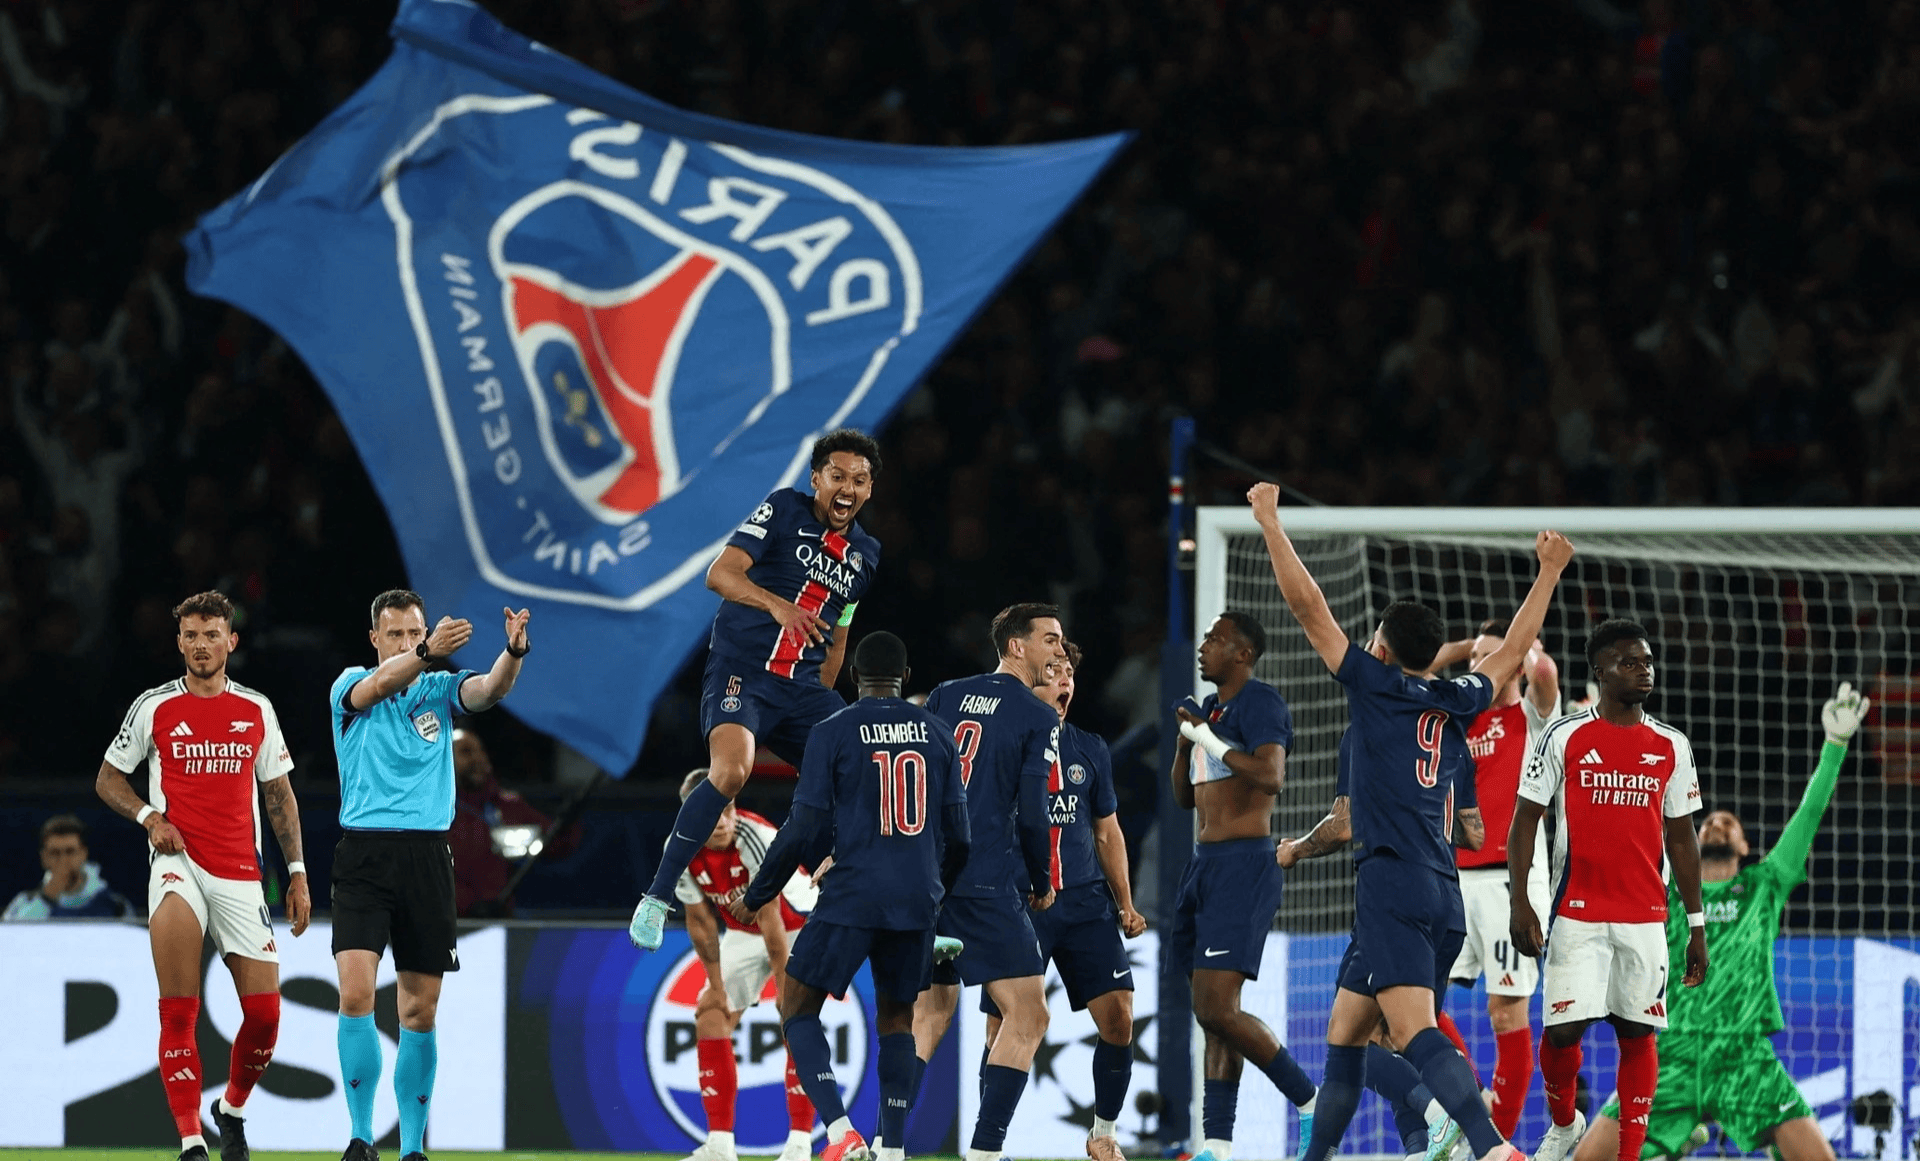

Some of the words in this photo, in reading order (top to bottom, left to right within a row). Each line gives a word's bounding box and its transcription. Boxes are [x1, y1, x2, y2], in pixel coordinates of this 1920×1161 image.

[795, 544, 854, 588] QATAR
[805, 567, 850, 597] AIRWAYS
[726, 675, 742, 696] 5
[171, 740, 253, 759] Emirates
[1416, 709, 1449, 788] 9
[185, 759, 203, 774] FLY
[205, 759, 242, 774] BETTER
[1580, 769, 1660, 792] Emirates
[871, 750, 926, 836] 10
[1592, 789, 1610, 804] FLY
[1612, 790, 1649, 807] BETTER
[258, 905, 274, 937] 4
[164, 1048, 191, 1058] AFC
[888, 1098, 907, 1108] PARIS
